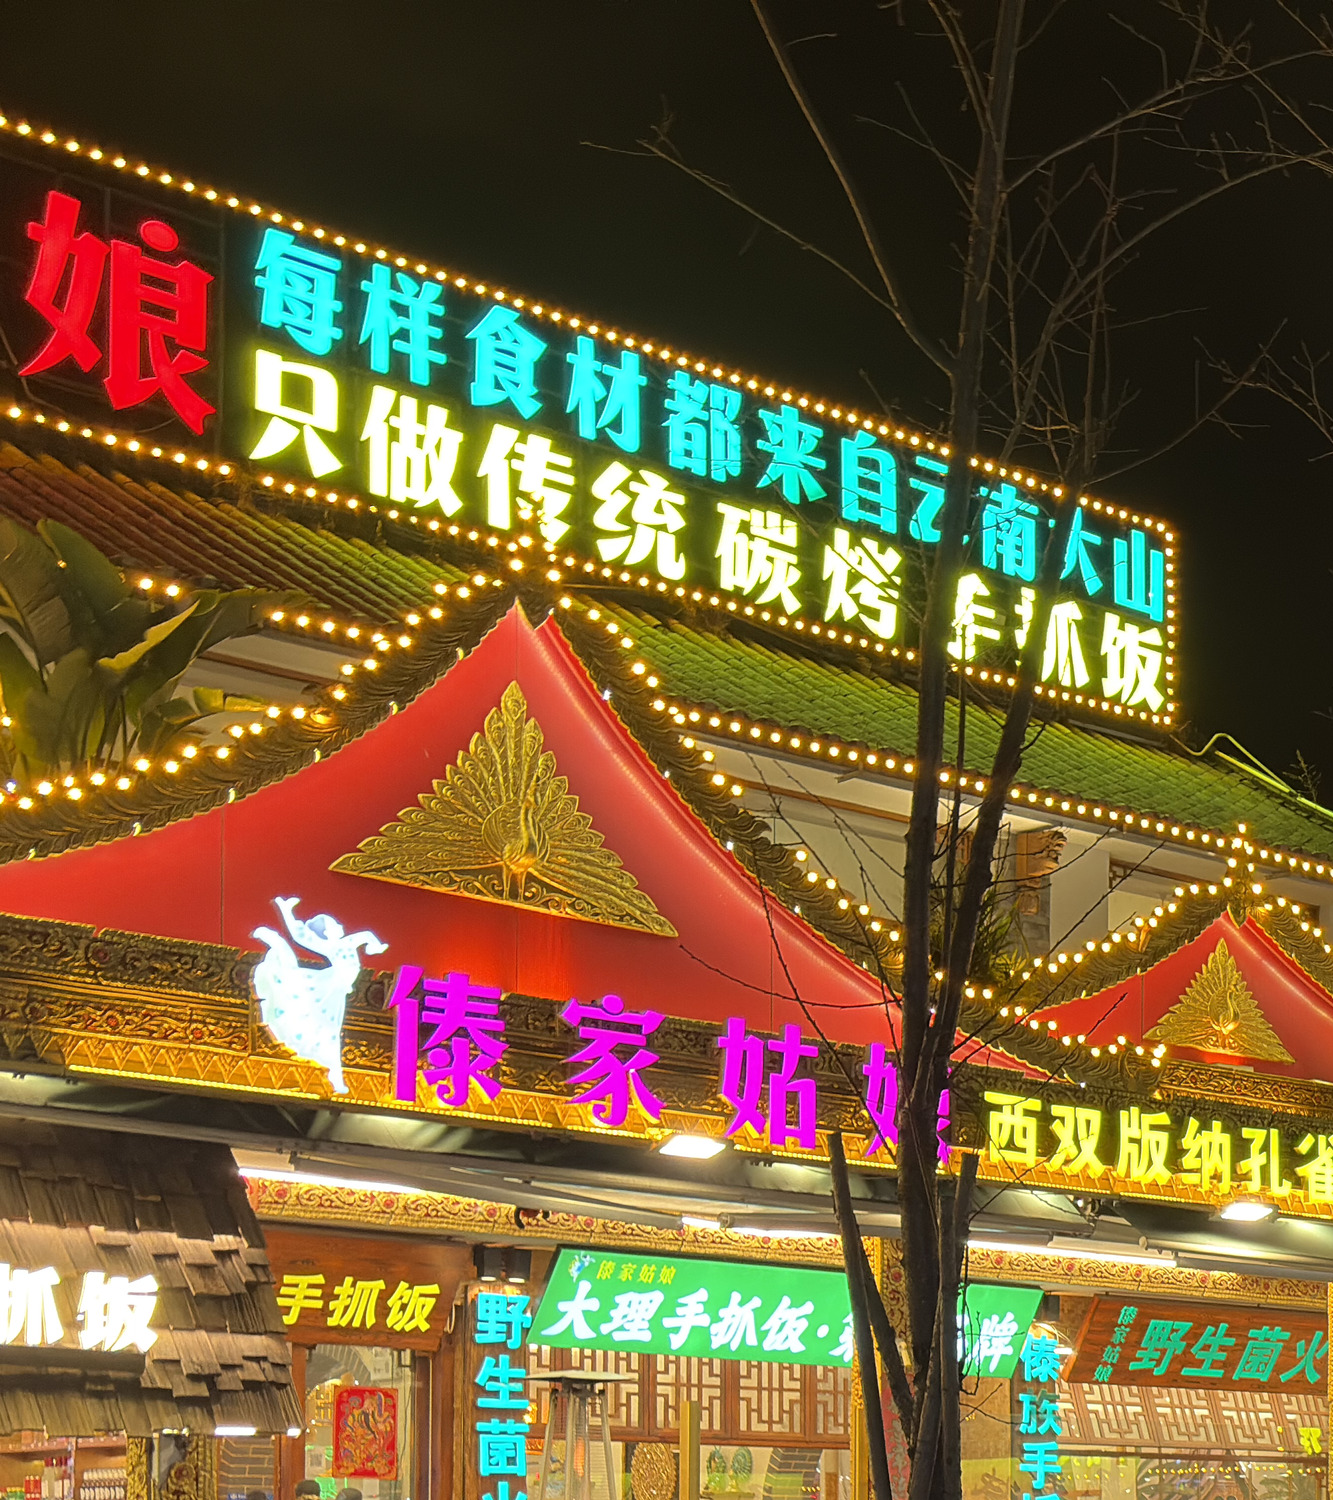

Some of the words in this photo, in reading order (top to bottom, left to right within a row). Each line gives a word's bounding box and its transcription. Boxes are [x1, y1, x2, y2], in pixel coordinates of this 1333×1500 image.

[19, 190, 216, 436] 娘
[255, 228, 1164, 620] 每样食材都来自云南大山
[249, 349, 1165, 713] 只做传统碳烤手抓饭
[277, 1273, 442, 1333] 手抓饭
[596, 1259, 677, 1285] 傣家姑娘
[541, 1280, 1019, 1373] 大理手抓饭·牌
[1093, 1305, 1138, 1382] 傣家姑娘
[1129, 1319, 1331, 1385] 野生菌火
